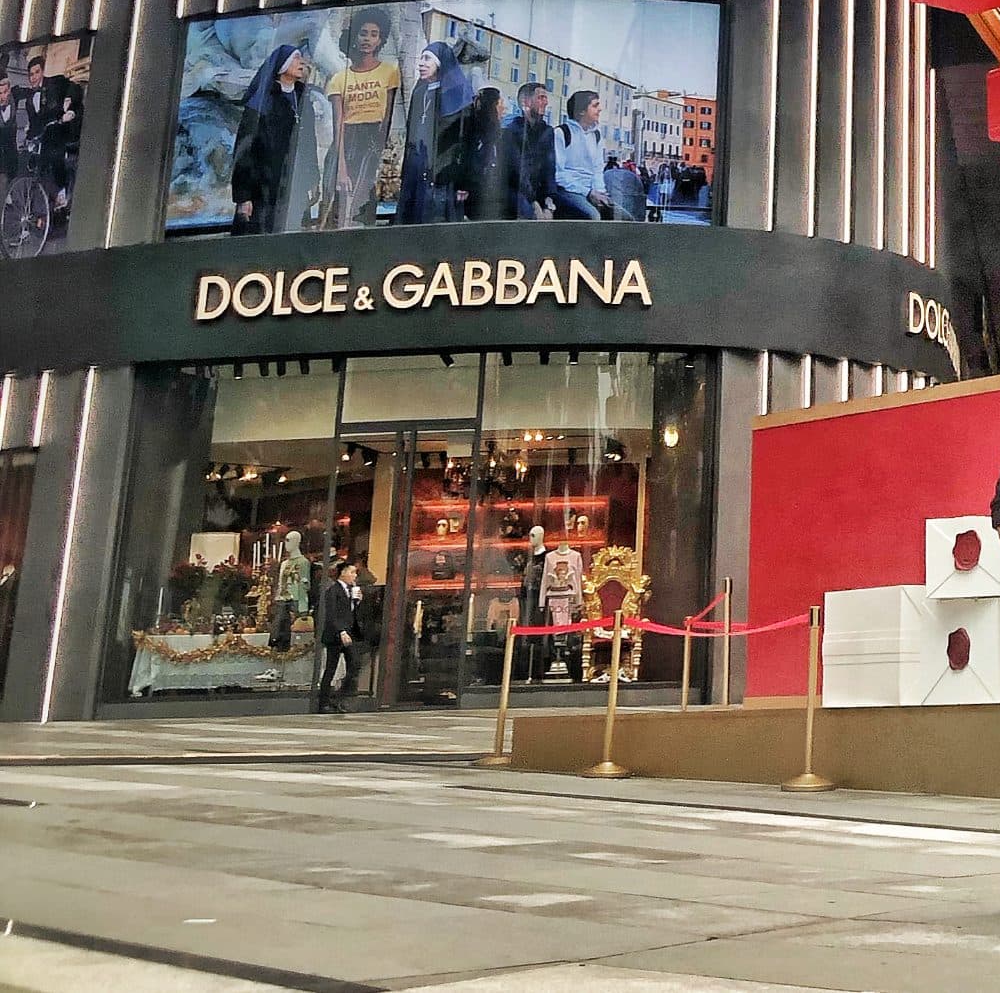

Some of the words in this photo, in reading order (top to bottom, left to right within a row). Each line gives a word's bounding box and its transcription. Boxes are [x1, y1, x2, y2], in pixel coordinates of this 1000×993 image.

[347, 81, 381, 92] SANTA
[348, 90, 379, 102] MODA
[197, 268, 349, 319] DOLCE
[353, 285, 376, 310] &
[383, 259, 652, 308] GABBANA
